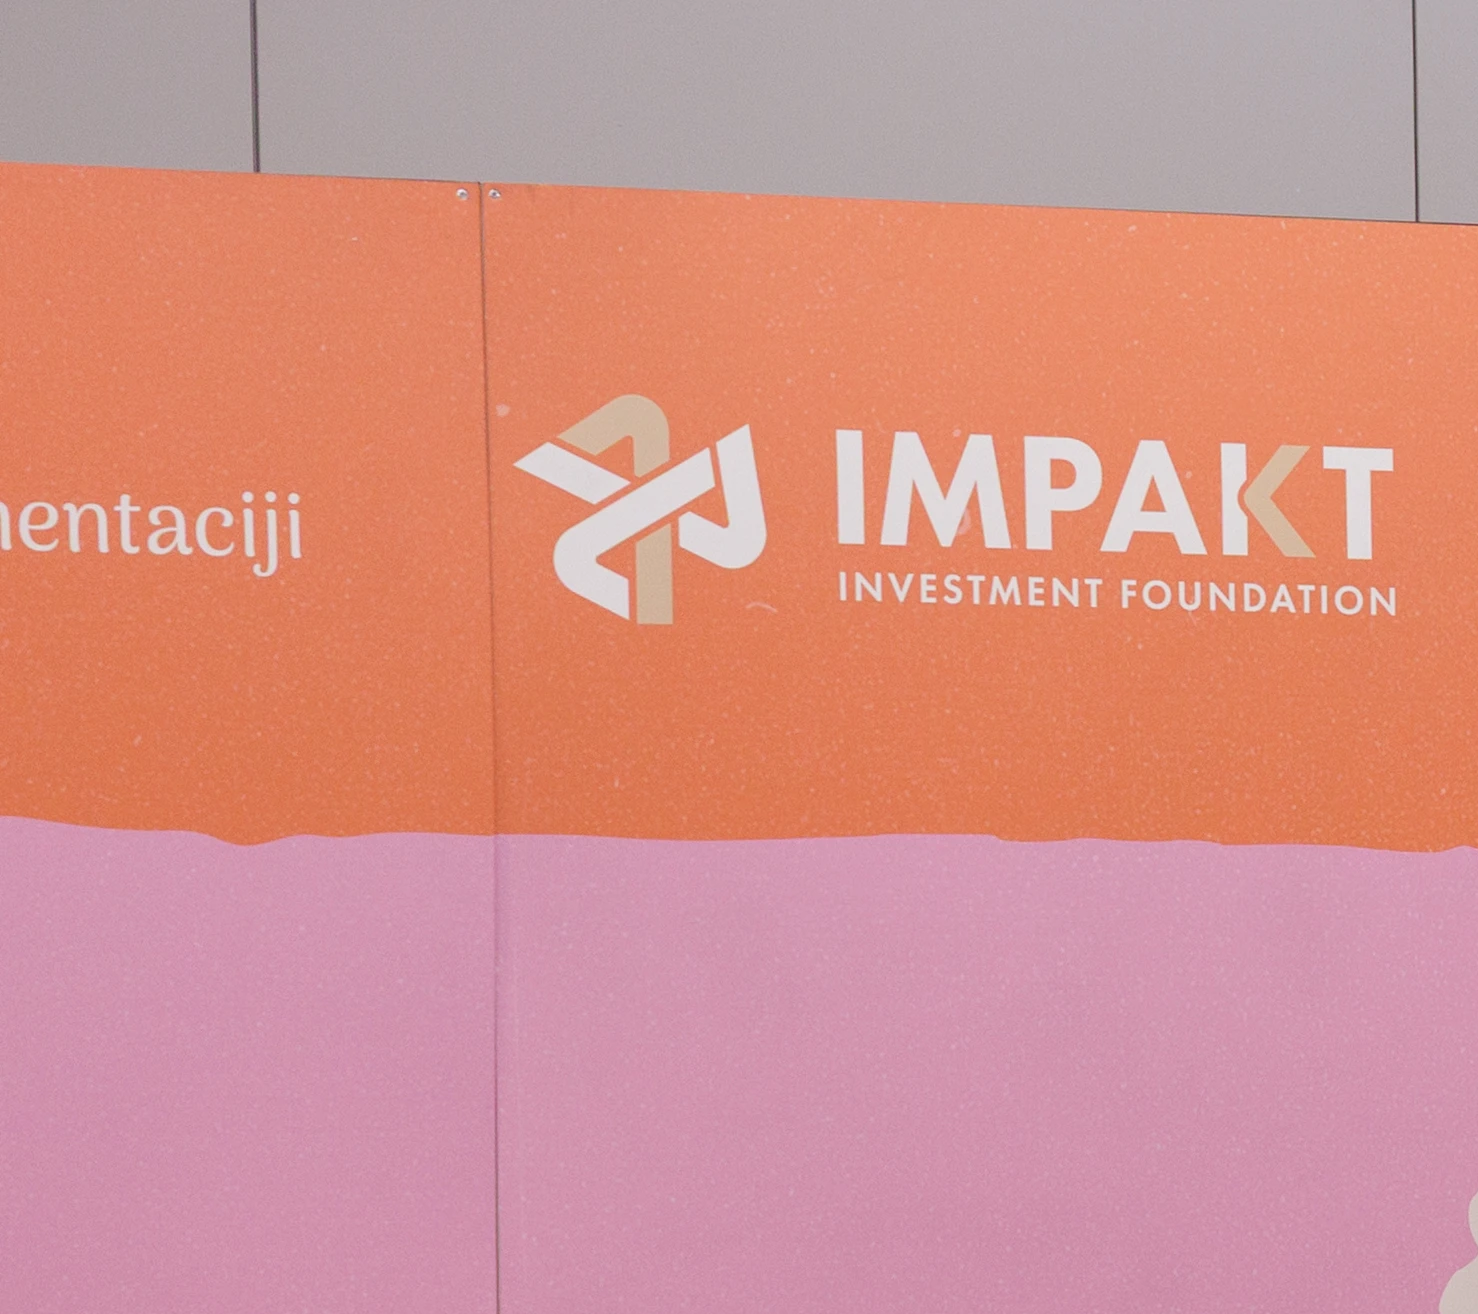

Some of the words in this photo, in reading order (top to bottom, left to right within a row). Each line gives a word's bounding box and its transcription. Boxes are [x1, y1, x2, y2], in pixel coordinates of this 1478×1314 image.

[835, 428, 1396, 561] IMPAKT
[837, 570, 1103, 610] INVESTMENT
[1120, 579, 1398, 617] FOUNDATION
